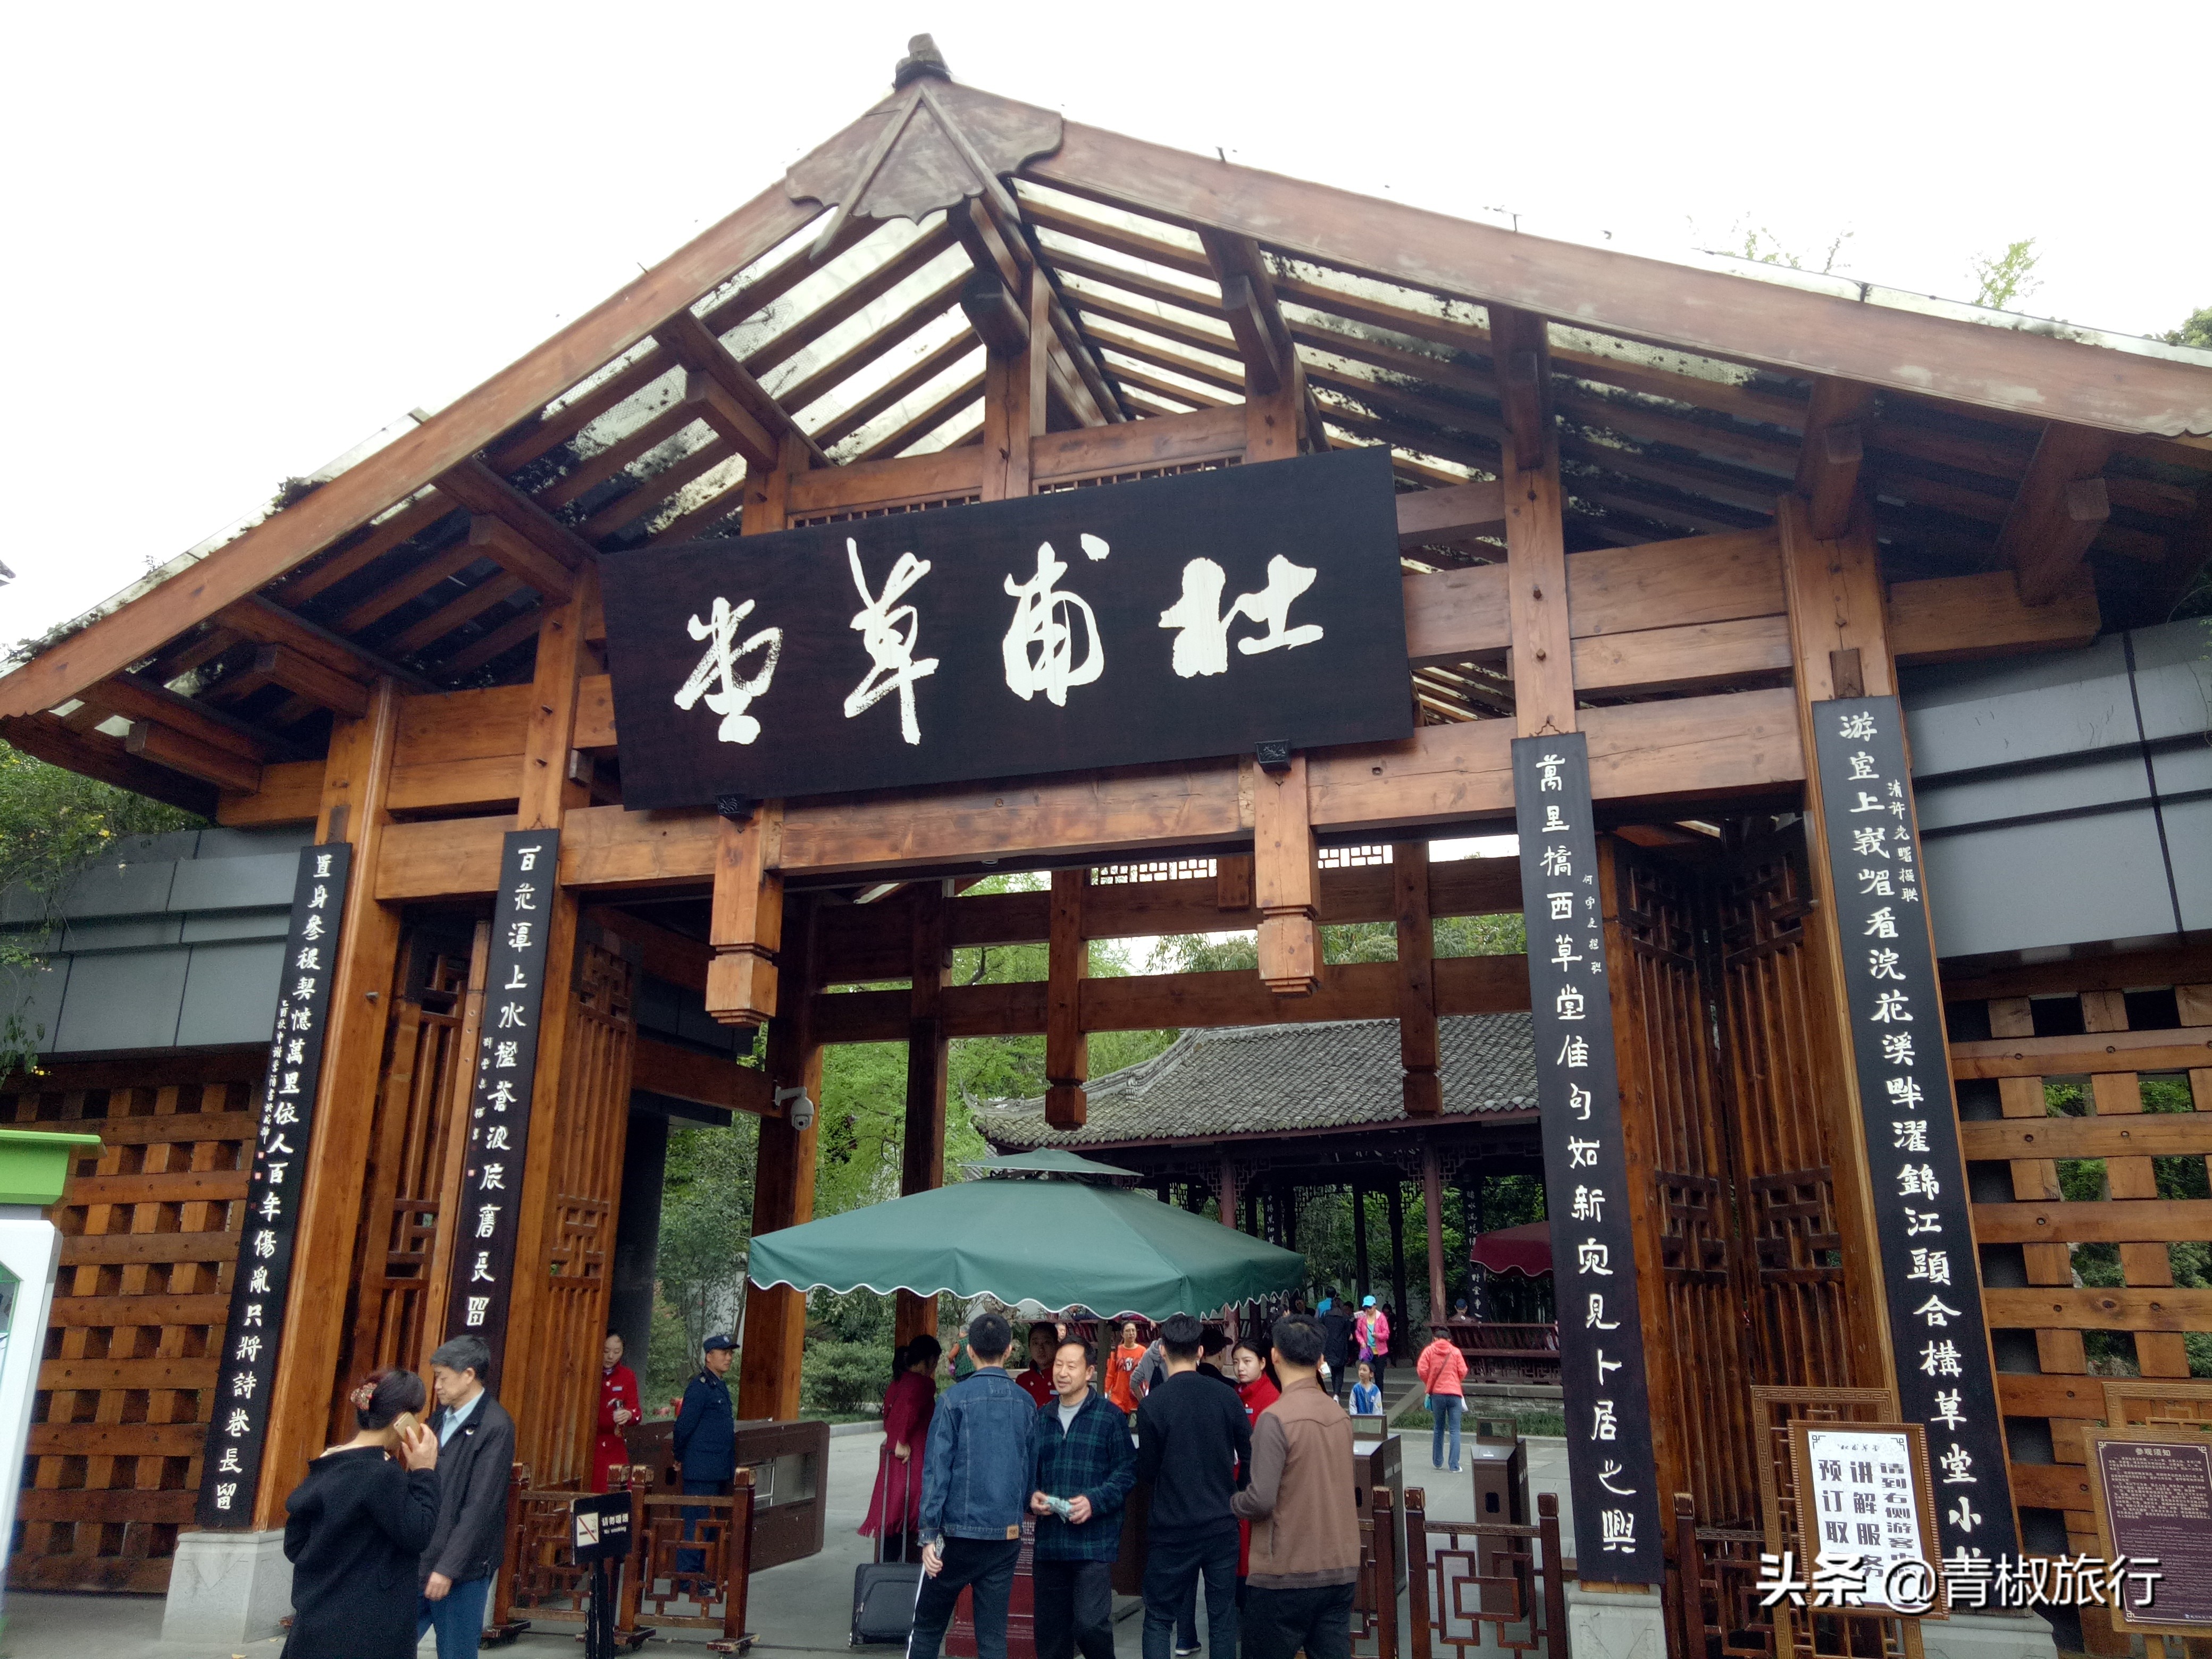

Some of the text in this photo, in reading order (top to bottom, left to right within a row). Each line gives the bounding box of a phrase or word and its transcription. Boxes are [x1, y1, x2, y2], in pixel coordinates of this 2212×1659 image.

[675, 534, 1323, 744] 杜甫草堂
[2135, 1448, 2171, 1456] 参观须知
[1818, 1460, 1856, 1575] 预订取
[1850, 1461, 1883, 1577] 讲解服务
